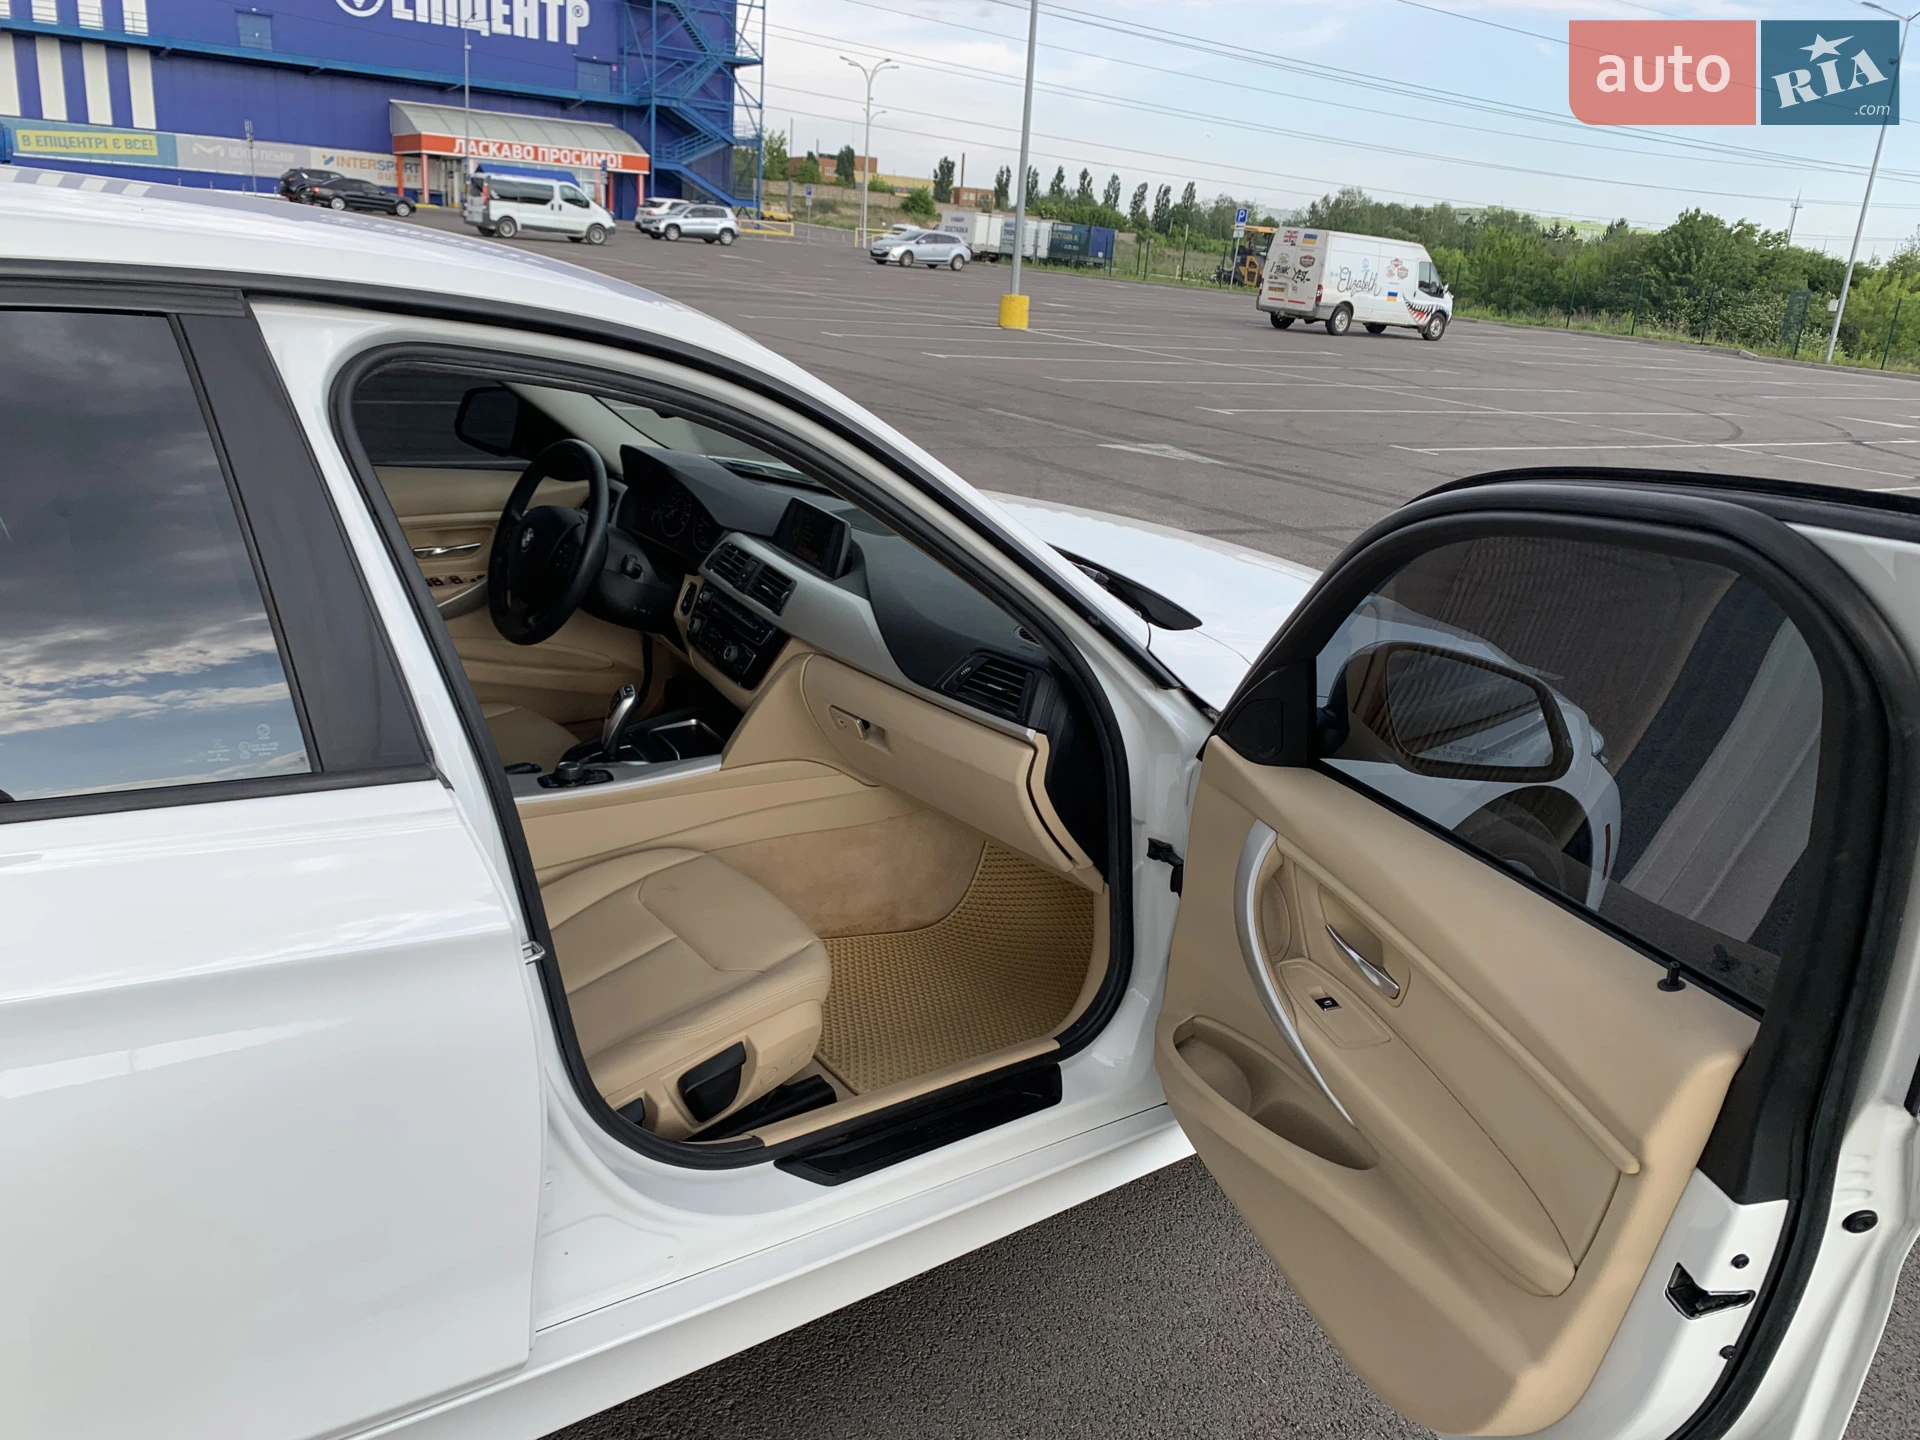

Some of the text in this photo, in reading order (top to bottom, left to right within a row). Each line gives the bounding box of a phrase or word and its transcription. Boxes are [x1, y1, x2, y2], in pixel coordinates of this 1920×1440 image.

[21, 134, 153, 151] В ЕПІЦЕНТРІ Є ВСЕ!
[453, 138, 623, 168] ЛАСКАВО ПРОСИМО!
[336, 155, 420, 173] INTERSPRT
[377, 172, 418, 183] OUTET
